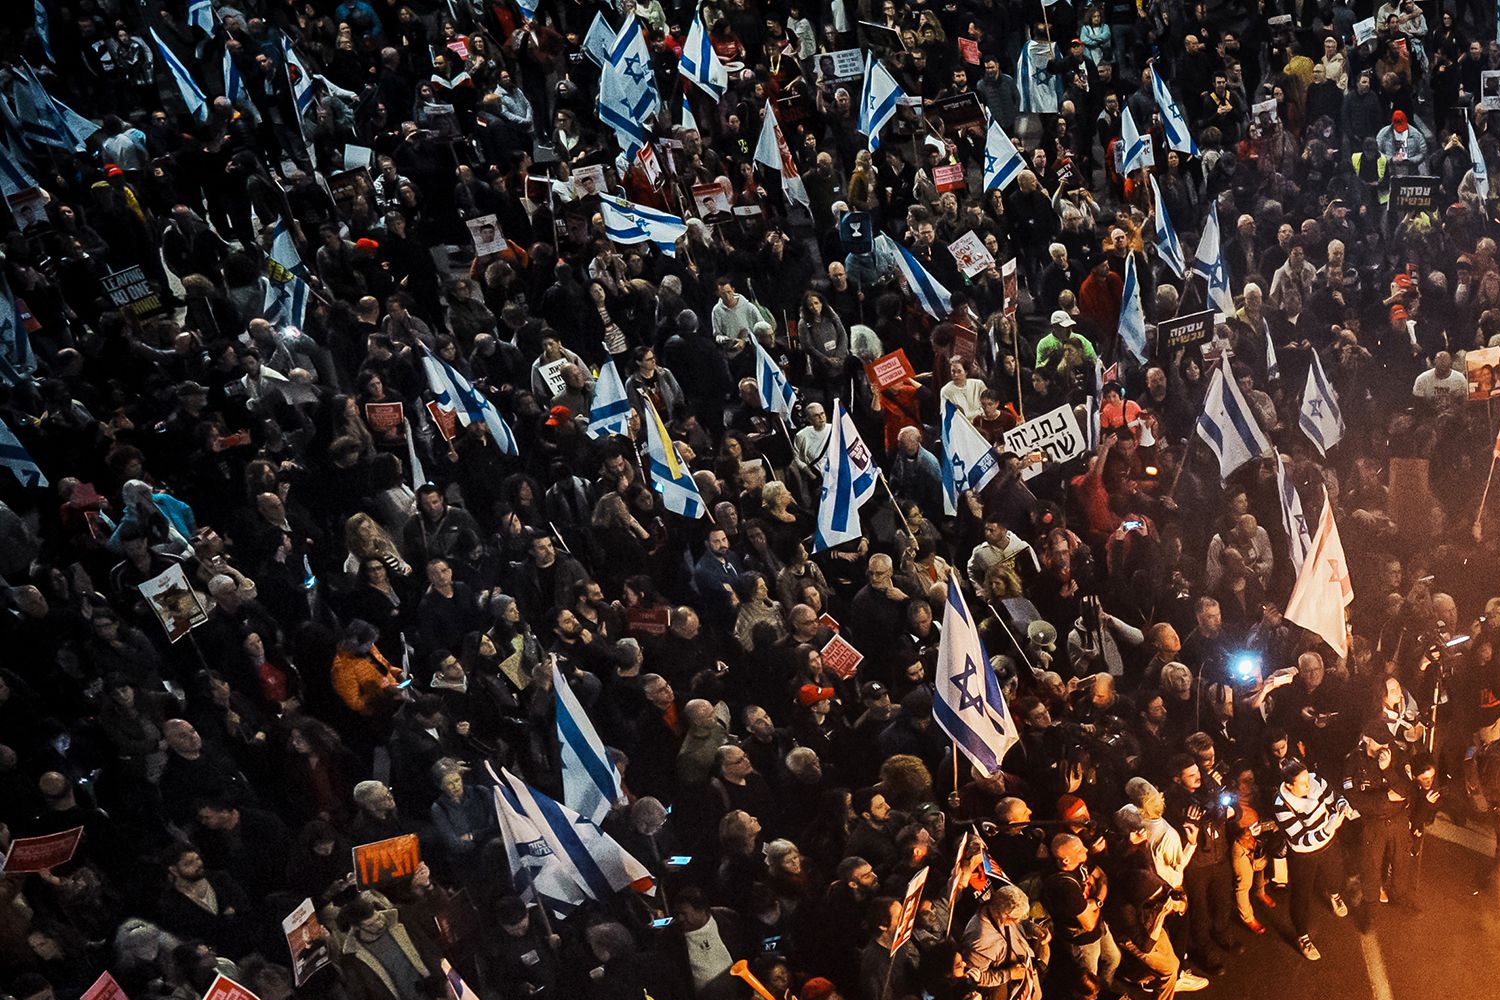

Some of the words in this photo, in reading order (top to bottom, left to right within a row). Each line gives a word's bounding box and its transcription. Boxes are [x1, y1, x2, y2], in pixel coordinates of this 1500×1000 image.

[1399, 186, 1432, 197] עסקה
[101, 268, 146, 291] LEAVING
[109, 290, 129, 306] NO
[128, 281, 153, 301] ONE
[1169, 321, 1205, 338] עסקה
[1009, 412, 1068, 452] נתניהו
